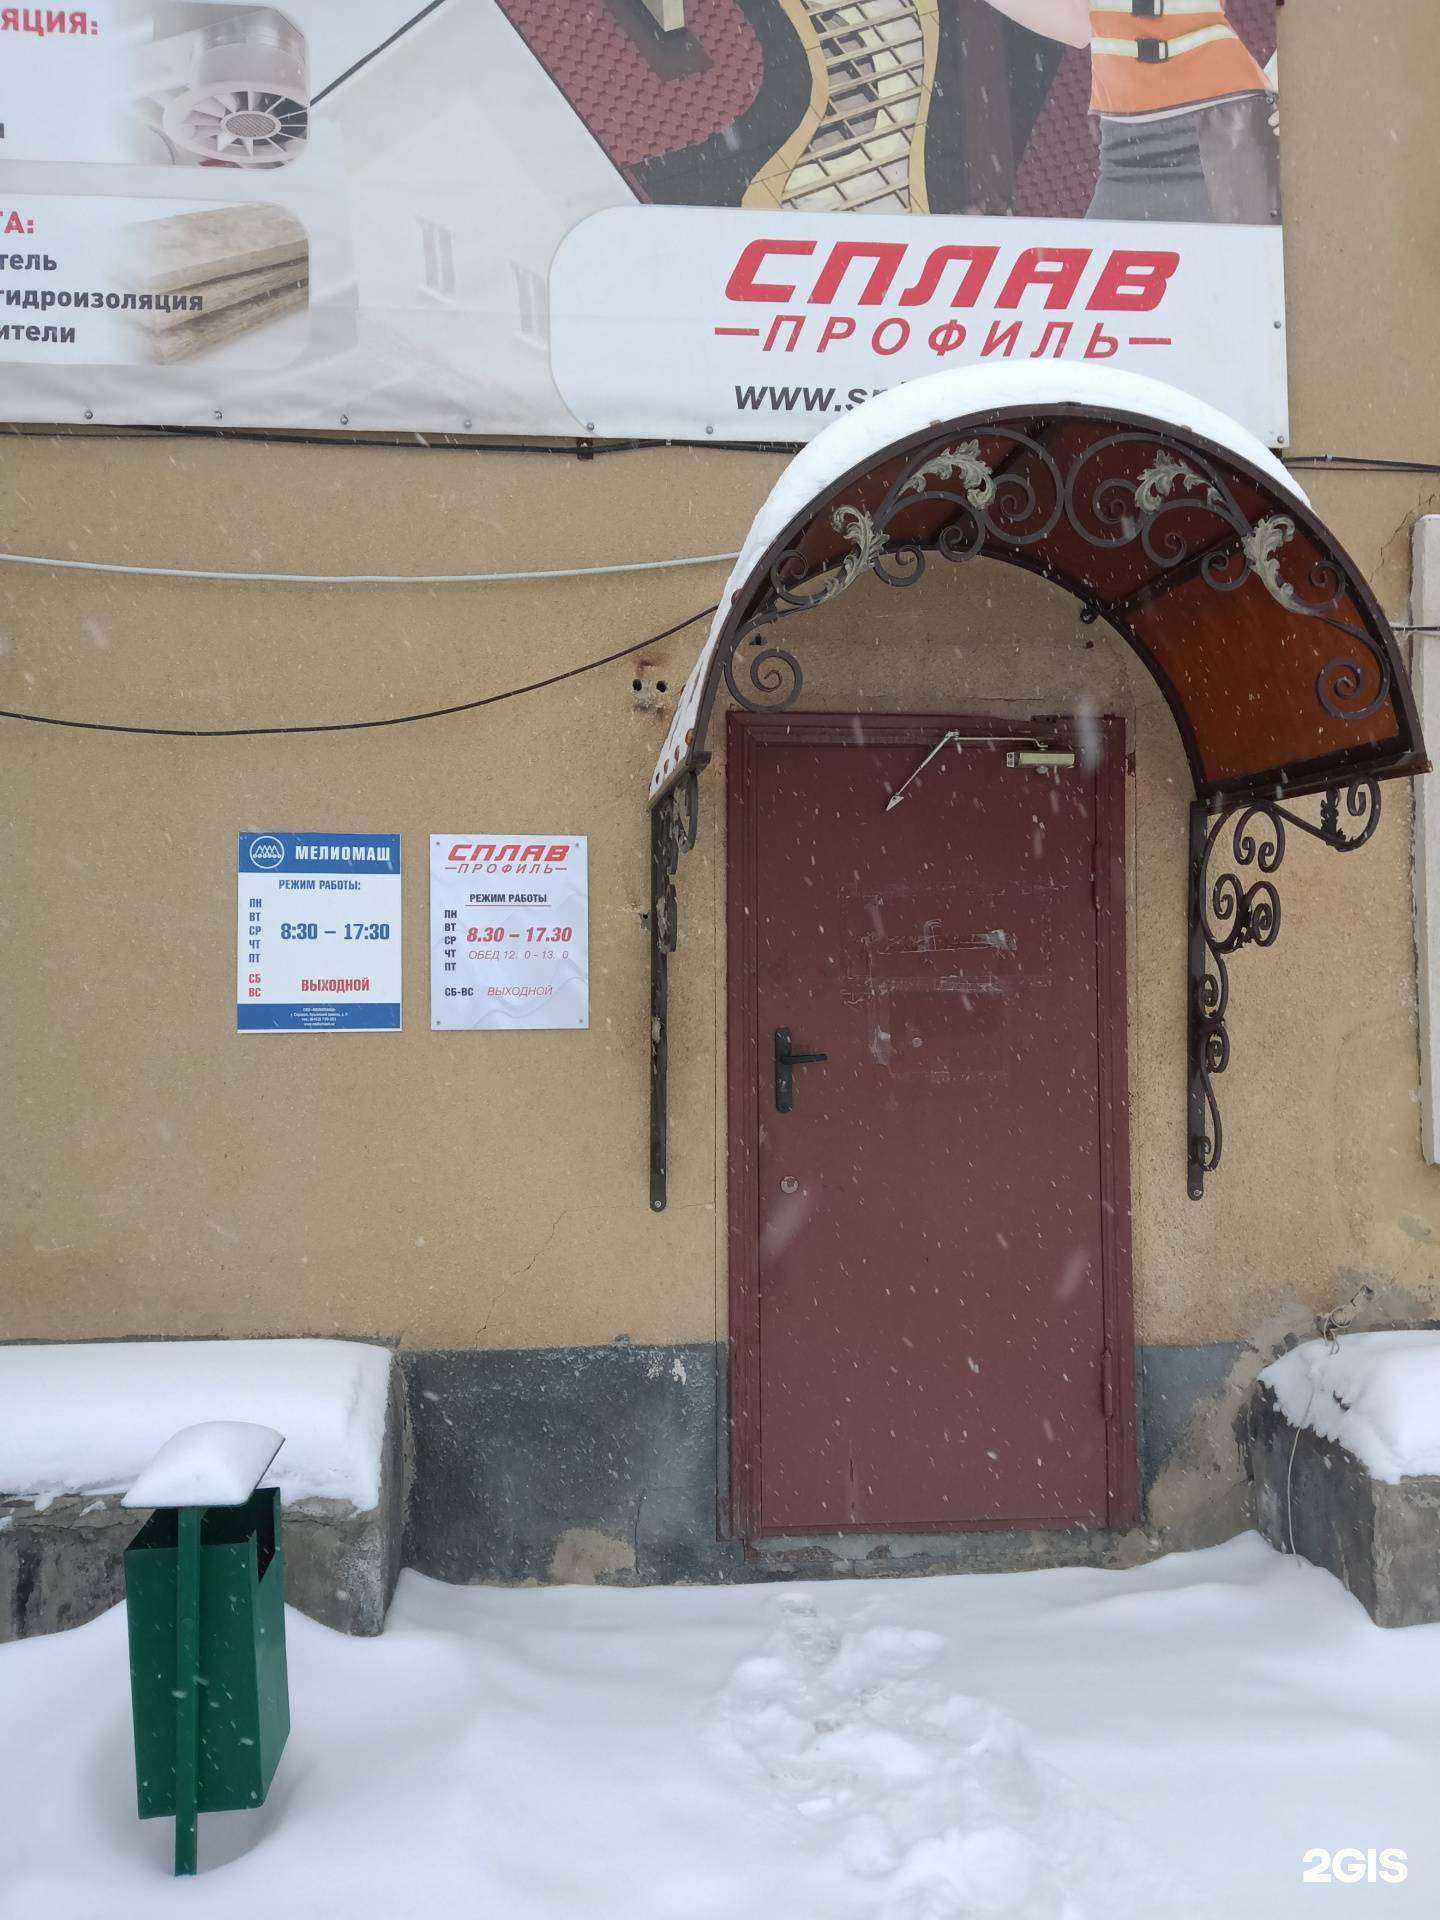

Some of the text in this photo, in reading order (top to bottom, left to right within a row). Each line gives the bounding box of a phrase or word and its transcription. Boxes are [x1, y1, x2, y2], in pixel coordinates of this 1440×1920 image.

[1, 8, 98, 37] ЯЦИЯ:
[725, 239, 1180, 312] СПЛАВ
[762, 314, 1118, 359] ПРОФИЛЬ
[295, 845, 390, 861] МЕЛИОМАШ
[447, 844, 570, 861] СПЛАВ
[457, 863, 553, 873] ПРОФИЛЬ
[278, 879, 361, 890] РЕЖИМ РАБОТЫ:
[249, 898, 262, 908] ПН
[469, 893, 547, 903] РЕЖИМ РАБОТЫ
[249, 912, 261, 922] ВТ
[444, 909, 457, 919] ПН
[249, 925, 261, 935] СР
[280, 923, 318, 940] 8:30
[344, 923, 390, 940] 17:30
[444, 922, 457, 932] ВТ
[466, 927, 505, 942] 8.30
[526, 927, 572, 942] 17.30
[249, 939, 261, 949] ЧТ
[444, 936, 457, 945] СР
[249, 953, 261, 963] ПТ
[444, 949, 457, 958] ЧТ
[468, 950, 500, 960] ОБЕД
[444, 962, 457, 971] ПТ
[248, 973, 261, 983] СБ
[301, 977, 370, 993] ВЫХОДНОЙ
[248, 987, 261, 997] ВС
[444, 985, 553, 997] СБ-ВС ВЫХОДНОЙ
